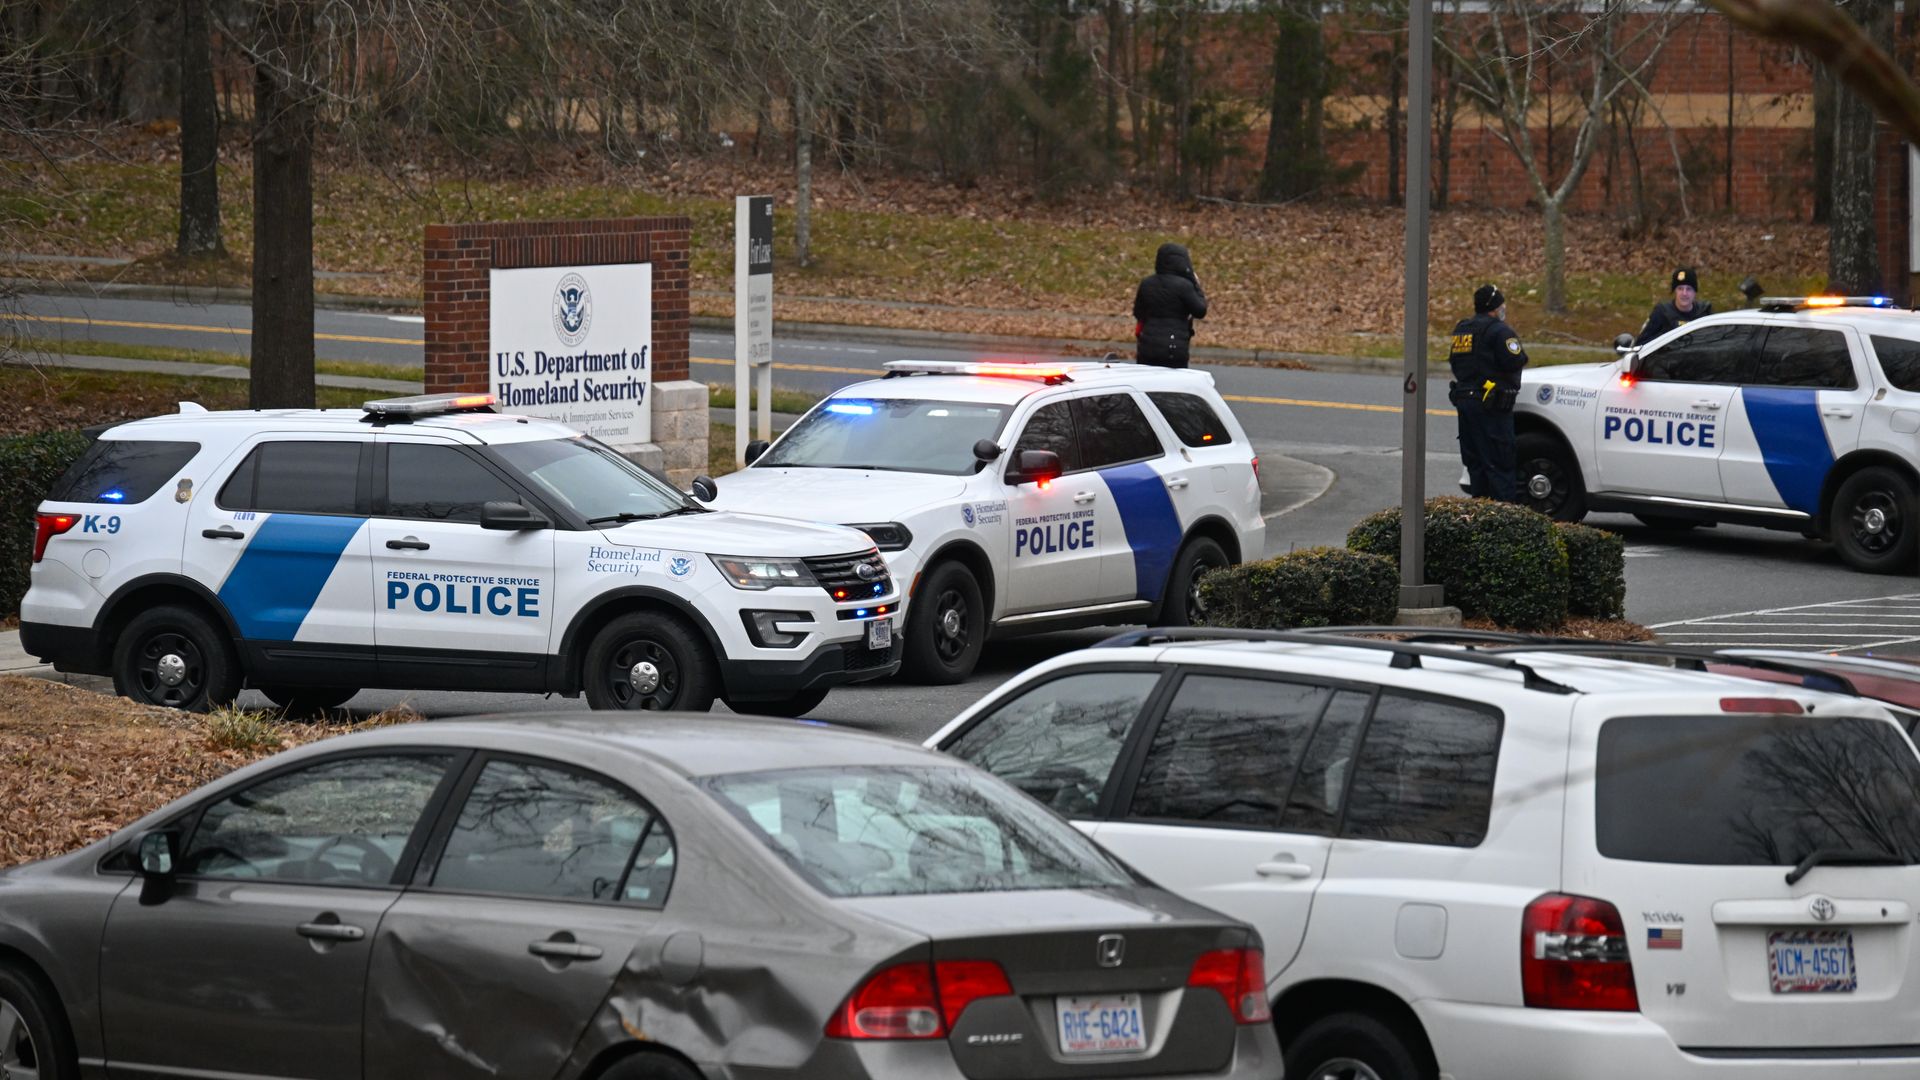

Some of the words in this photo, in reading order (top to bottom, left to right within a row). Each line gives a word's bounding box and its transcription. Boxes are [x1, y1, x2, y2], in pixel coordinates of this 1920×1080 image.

[497, 351, 530, 377] U.S.
[534, 347, 627, 381] Department
[631, 345, 648, 370] of
[498, 379, 579, 407] Homeland
[583, 376, 647, 406] Security
[1404, 372, 1417, 394] 6
[1556, 386, 1598, 399] Homeland
[1554, 397, 1587, 410] Security
[569, 411, 607, 425] Immigration
[608, 408, 634, 420] Services
[1605, 406, 1637, 415] FEDERAL
[1639, 409, 1683, 419] PROTECTIVE
[1686, 413, 1716, 422] SERVICE
[590, 425, 629, 437] Enforcement
[1604, 415, 1716, 448] POLICE
[975, 500, 1007, 514] Homeland
[83, 515, 122, 534] K-9
[977, 513, 1002, 526] Security
[1015, 516, 1039, 526] FEDERAL
[1039, 512, 1071, 523] PROTECTIVE
[1072, 509, 1094, 519] SERVICE
[1015, 520, 1095, 558] POLICE
[589, 546, 662, 563] Homeland
[587, 560, 644, 577] Security
[387, 571, 431, 581] FEDERAL
[433, 574, 495, 585] PROTECTIVE
[497, 577, 540, 587] SERVICE
[386, 580, 540, 618] POLICE
[1775, 947, 1847, 975] VCM-4567
[1063, 1008, 1139, 1040] RHE-6424
